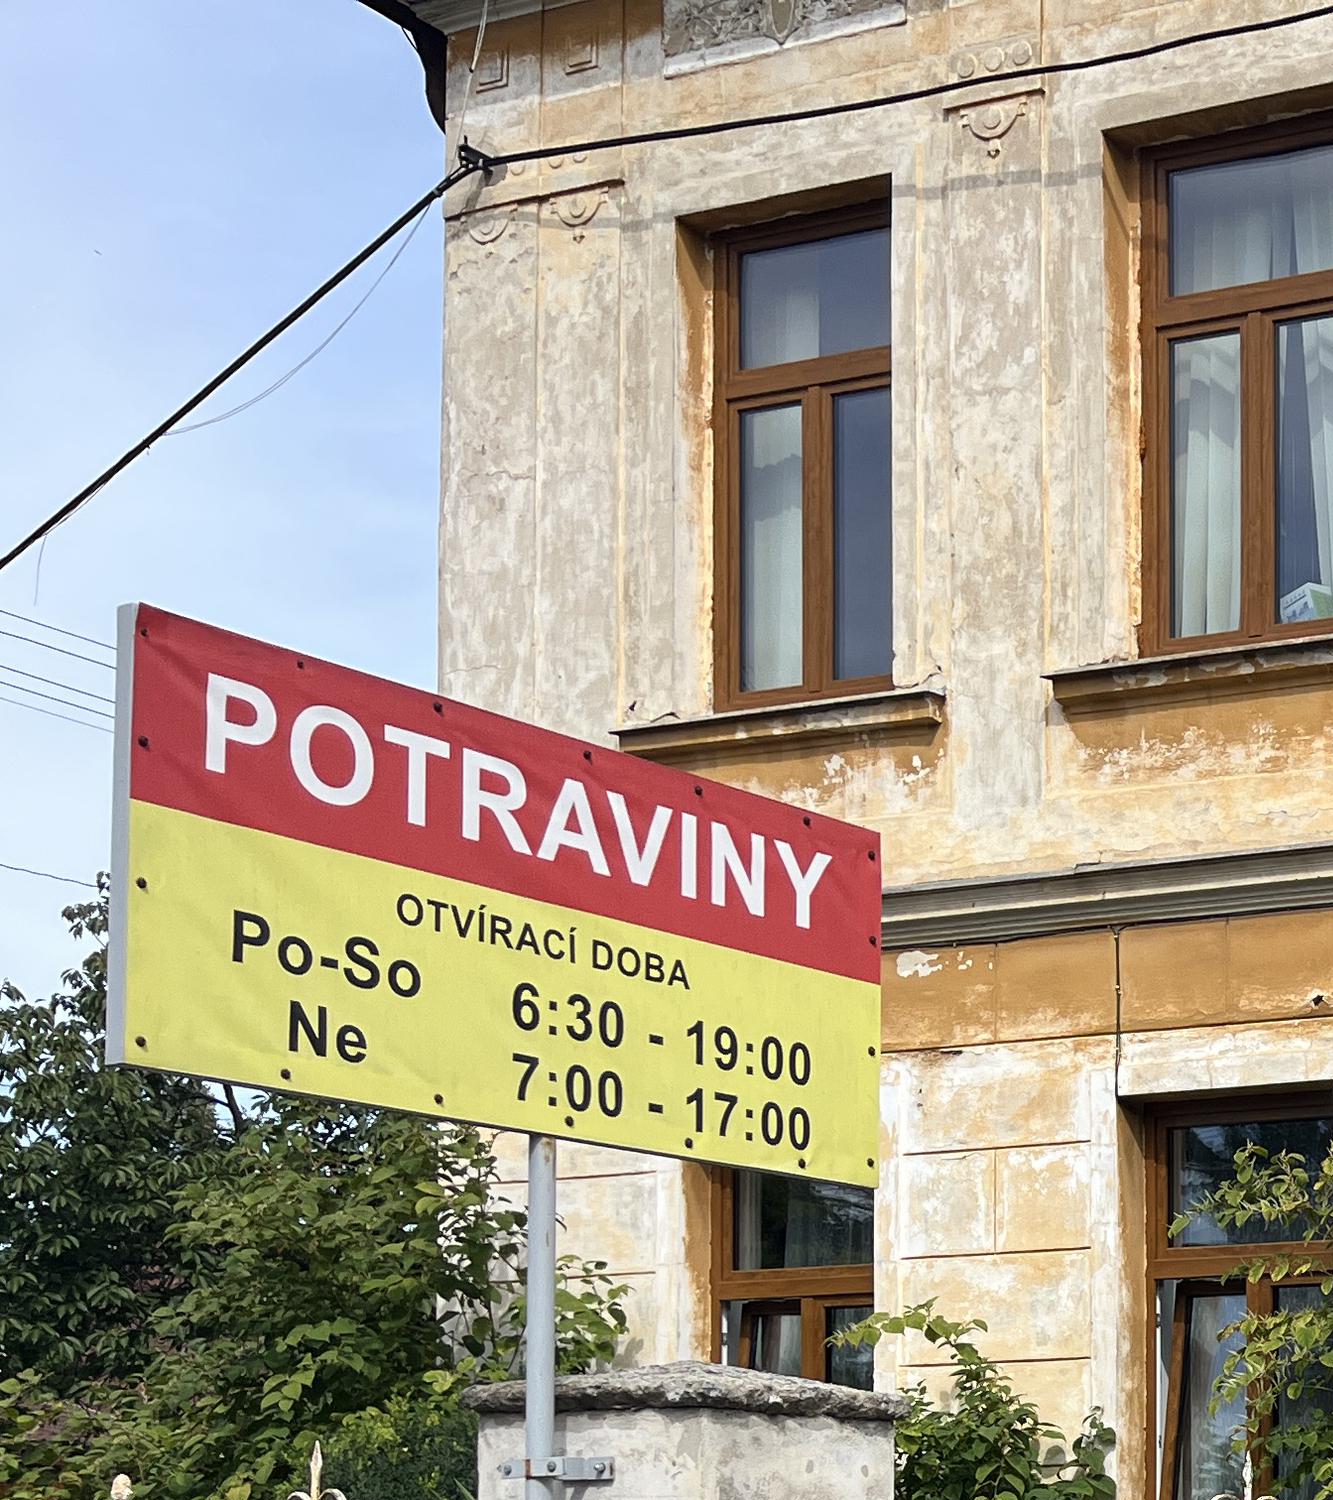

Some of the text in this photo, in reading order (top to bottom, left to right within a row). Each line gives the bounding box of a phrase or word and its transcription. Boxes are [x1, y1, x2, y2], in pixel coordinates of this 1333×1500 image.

[205, 672, 832, 929] POTRAVINY
[231, 909, 421, 998] Po-So
[512, 982, 625, 1048] 6:30
[686, 1020, 811, 1086] 19:00
[396, 893, 691, 990] OTVÍRACÍ DOBA
[288, 999, 368, 1064] Ne
[512, 1052, 624, 1118] 7:00
[686, 1087, 811, 1151] 17:00
